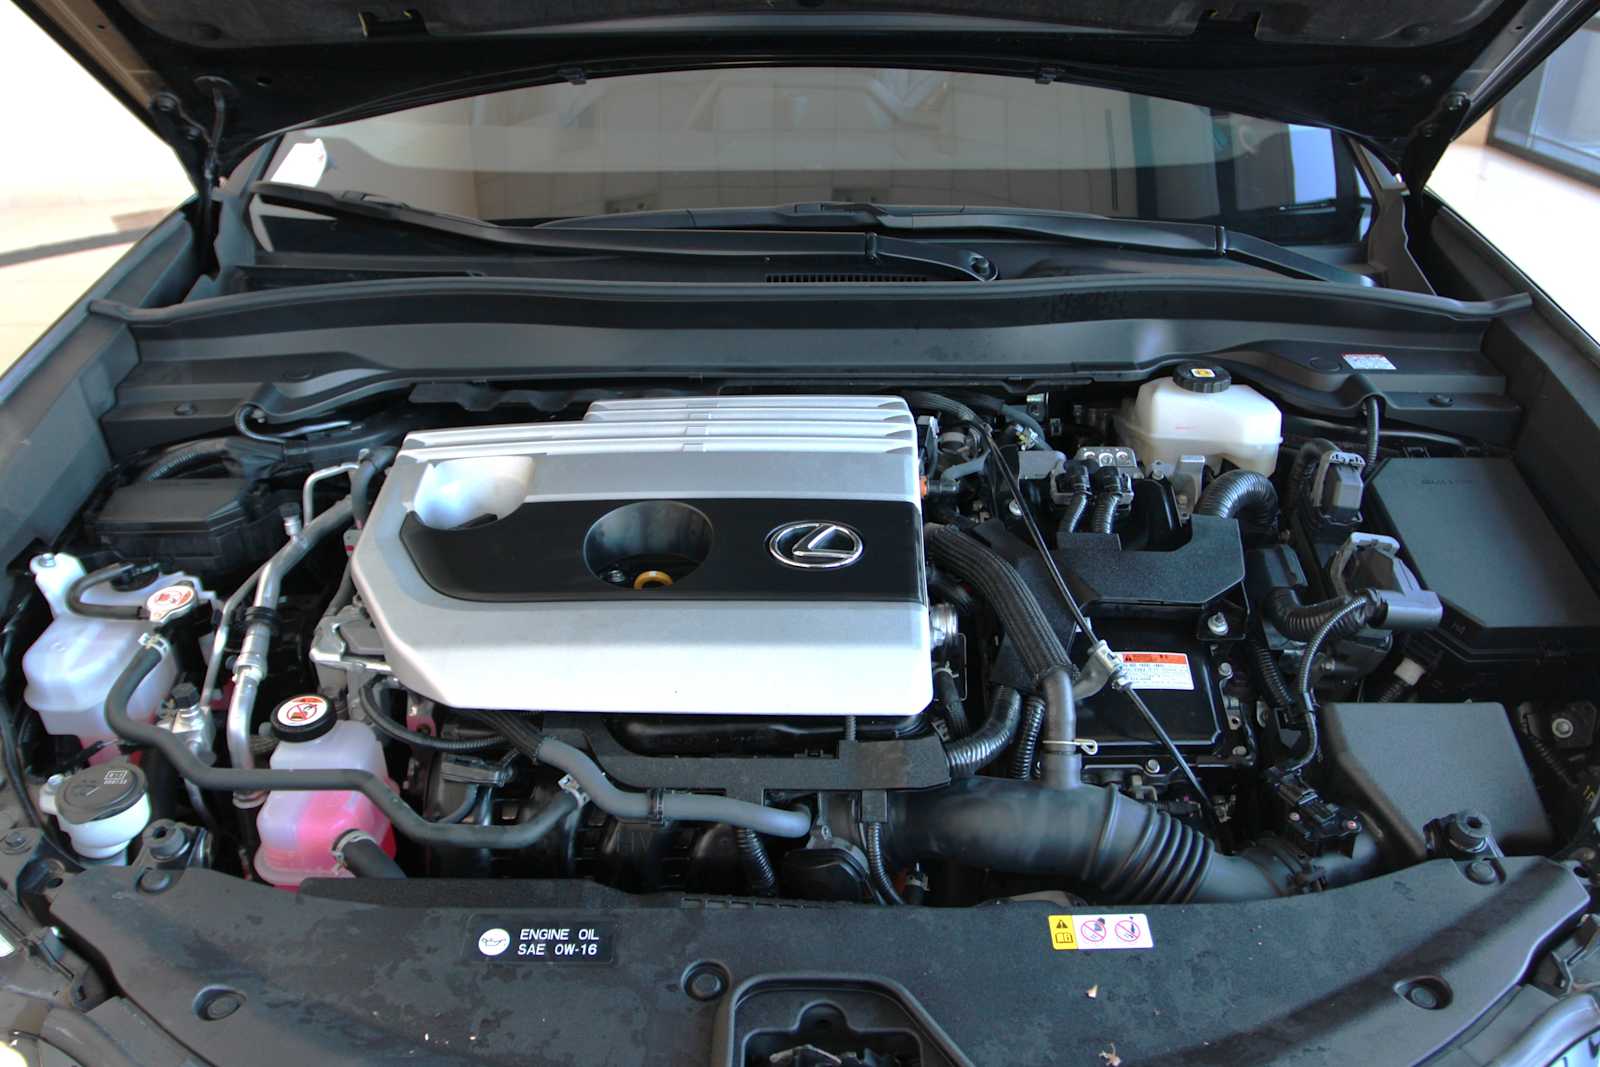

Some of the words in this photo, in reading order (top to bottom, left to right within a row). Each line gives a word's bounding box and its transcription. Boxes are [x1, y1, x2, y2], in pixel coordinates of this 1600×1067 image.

[520, 928, 570, 940] ENGINE
[578, 928, 600, 940] OIL
[517, 943, 546, 956] SAE
[554, 943, 598, 956] 0W-16
